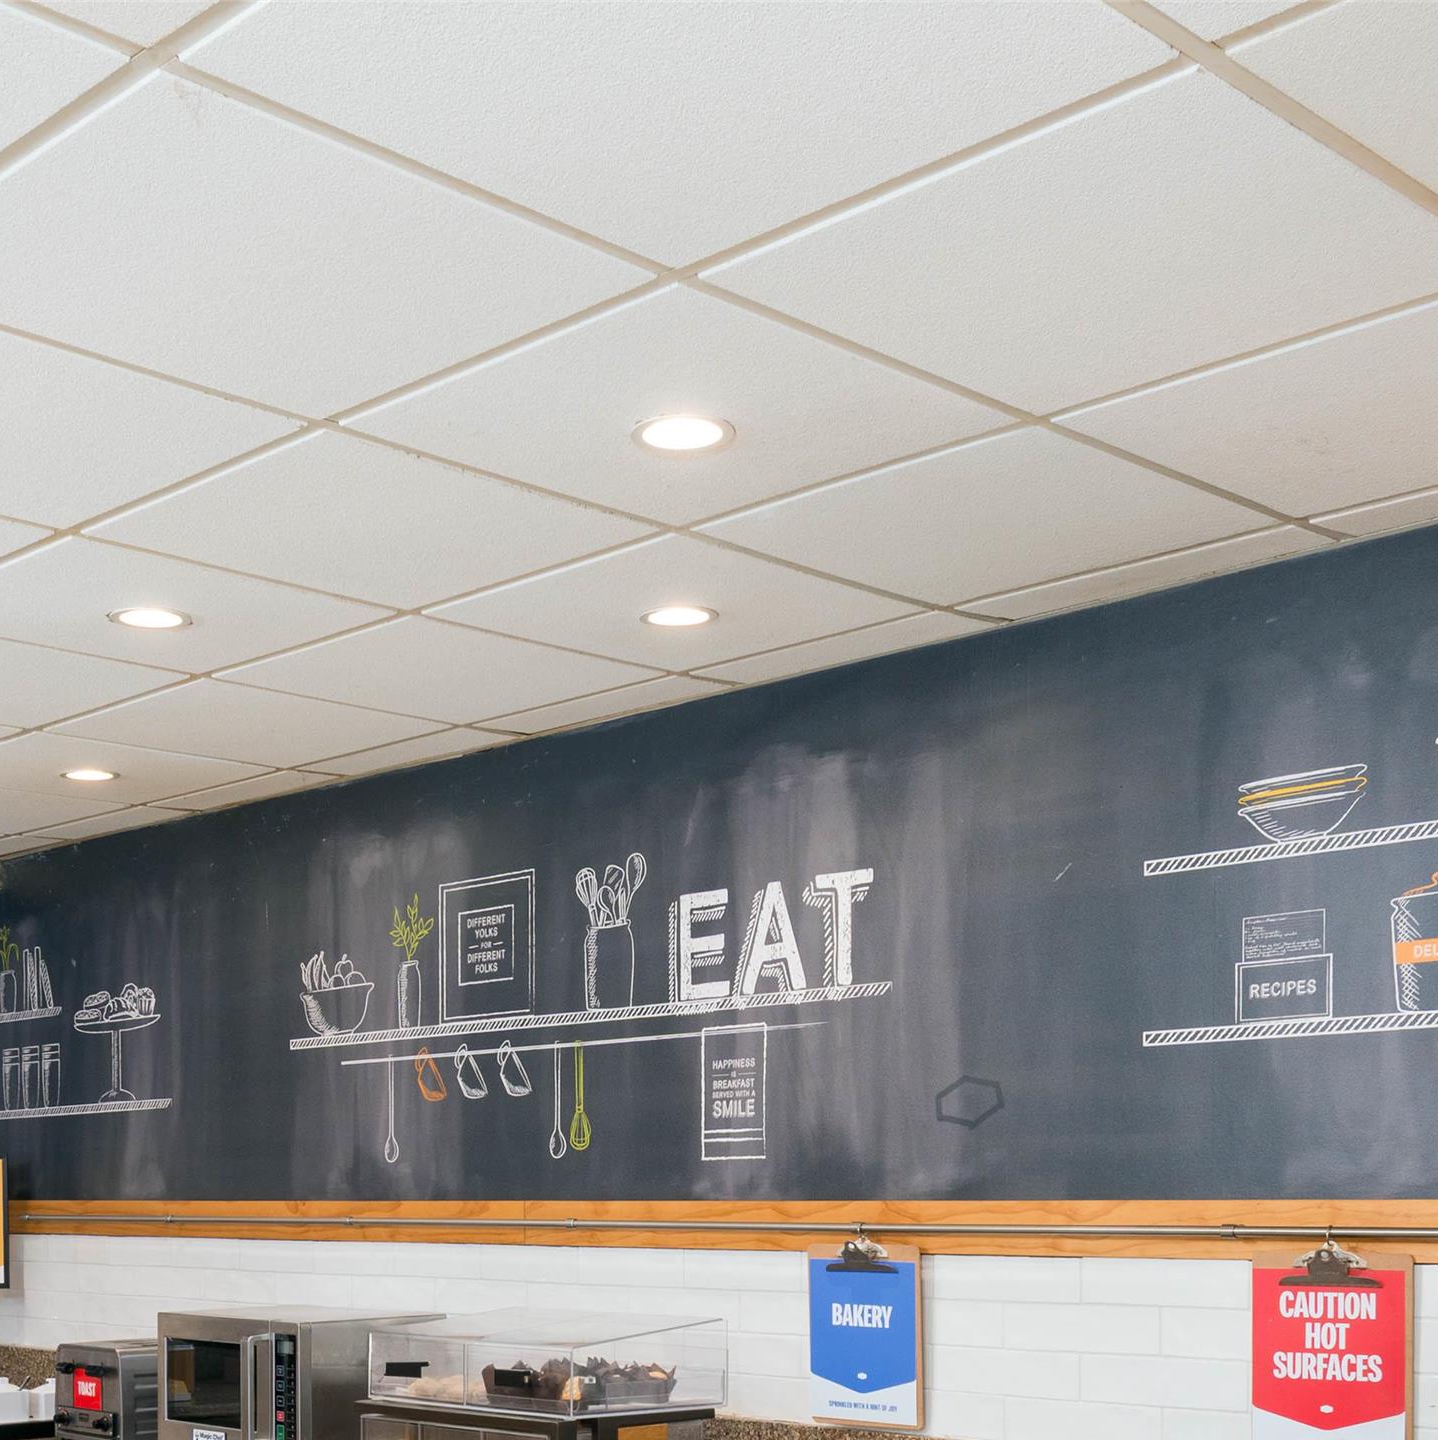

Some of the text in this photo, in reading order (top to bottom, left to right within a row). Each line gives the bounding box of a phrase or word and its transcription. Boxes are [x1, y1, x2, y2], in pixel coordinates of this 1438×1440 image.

[466, 913, 506, 929] DIFFERENT
[474, 926, 499, 939] YOLKS
[668, 868, 874, 1004] EAT
[480, 941, 493, 950] FOR
[466, 949, 506, 964] DIFFERENT
[474, 962, 499, 975] FOLKS
[1249, 978, 1317, 999] RECIPES
[712, 1057, 756, 1070] HAPPINESS
[712, 1078, 755, 1090] BREAKFAST
[712, 1098, 756, 1119] SMILE
[1279, 1290, 1377, 1320] CAUTION
[831, 1302, 893, 1329] BAKERY
[1304, 1322, 1350, 1350] HOT
[1273, 1351, 1383, 1383] SURFACES
[77, 1380, 96, 1397] TOAST
